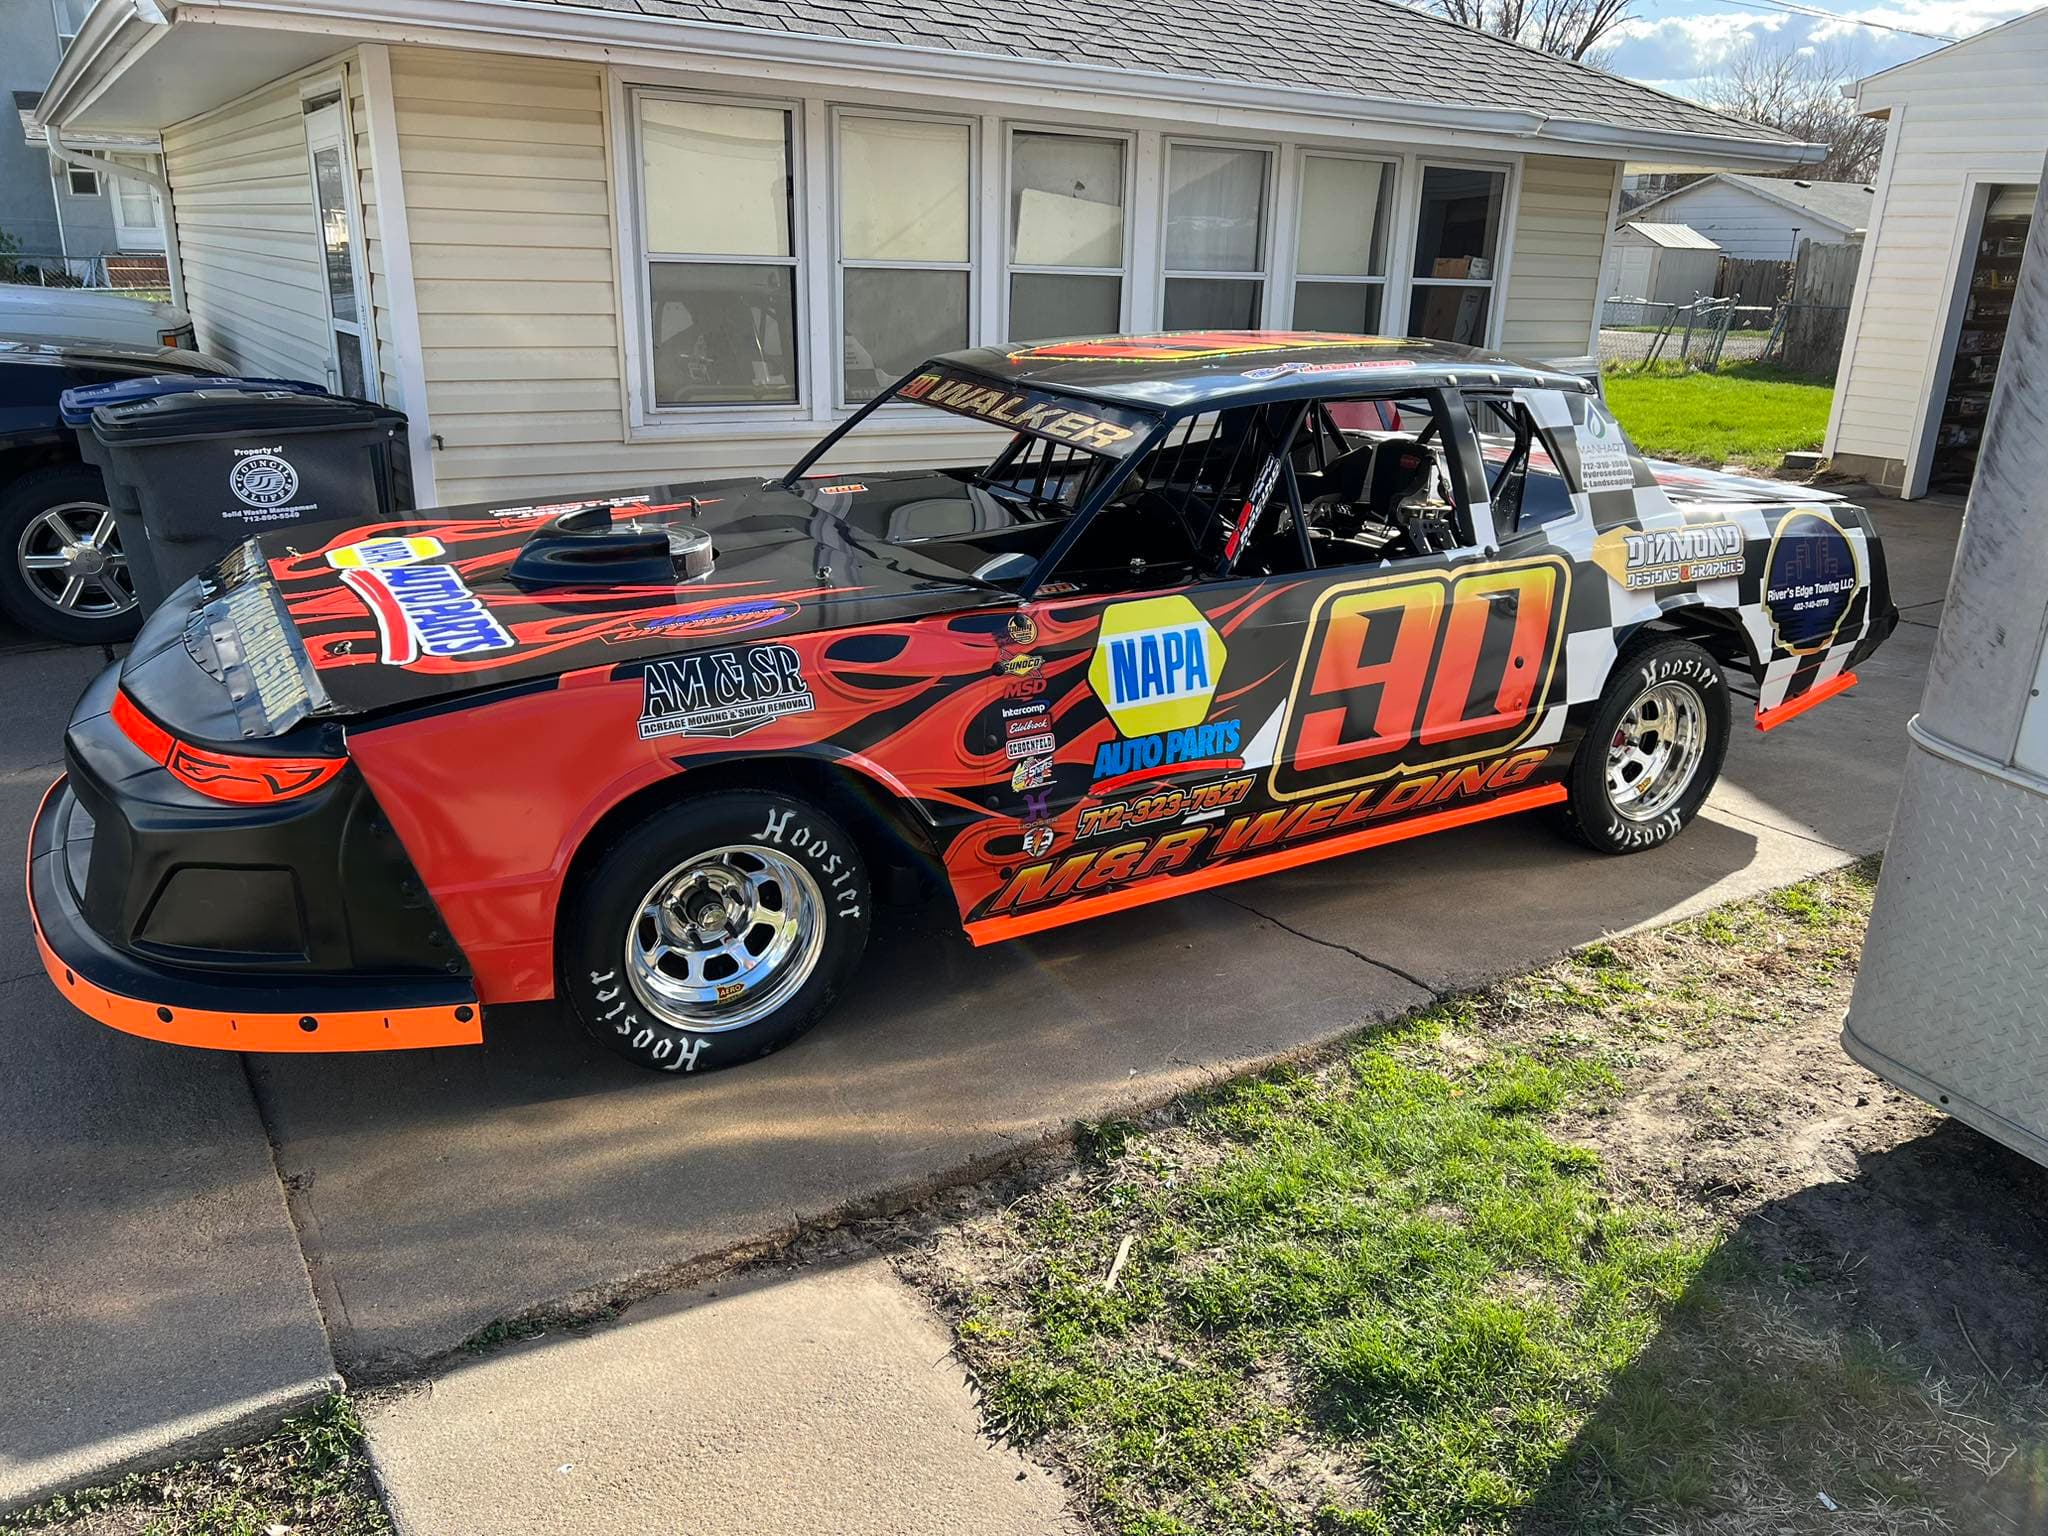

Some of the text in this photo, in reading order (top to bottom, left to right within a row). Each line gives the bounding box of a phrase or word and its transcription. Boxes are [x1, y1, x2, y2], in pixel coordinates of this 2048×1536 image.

[929, 380, 1135, 449] WALKER
[234, 446, 283, 457] Property of
[236, 460, 291, 481] COUNCIL
[1583, 469, 1633, 479] Hydroseeding
[239, 483, 292, 503] BLUFFS
[222, 503, 318, 519] Solid Waste Management
[1767, 578, 1855, 602] River's Edge Towing LLC
[405, 601, 508, 654] PARTS
[1003, 658, 1041, 671] SUNOCO
[1109, 628, 1208, 704] NAPA
[1293, 566, 1557, 771] 90
[1641, 657, 1719, 690] Hoosier
[640, 645, 809, 720] AM & SR
[1003, 679, 1048, 699] MSD
[643, 719, 687, 735] ACREAGE
[687, 711, 728, 728] MOWING
[738, 704, 767, 719] SNOW
[767, 698, 809, 714] REMOVAL
[1002, 704, 1046, 718] Intercomp
[1009, 719, 1049, 735] Edelbrock
[1008, 736, 1052, 756] SCHOENFELD
[1093, 735, 1163, 779] AUTO
[1165, 719, 1241, 765] PARTS
[1080, 777, 1255, 837] 712-323-7527
[994, 748, 1550, 908] M&R WELDING
[1607, 807, 1682, 850] Hoosier
[750, 807, 862, 919] Hoosier
[719, 984, 742, 997] AERO
[590, 968, 711, 1071] Hoosier
